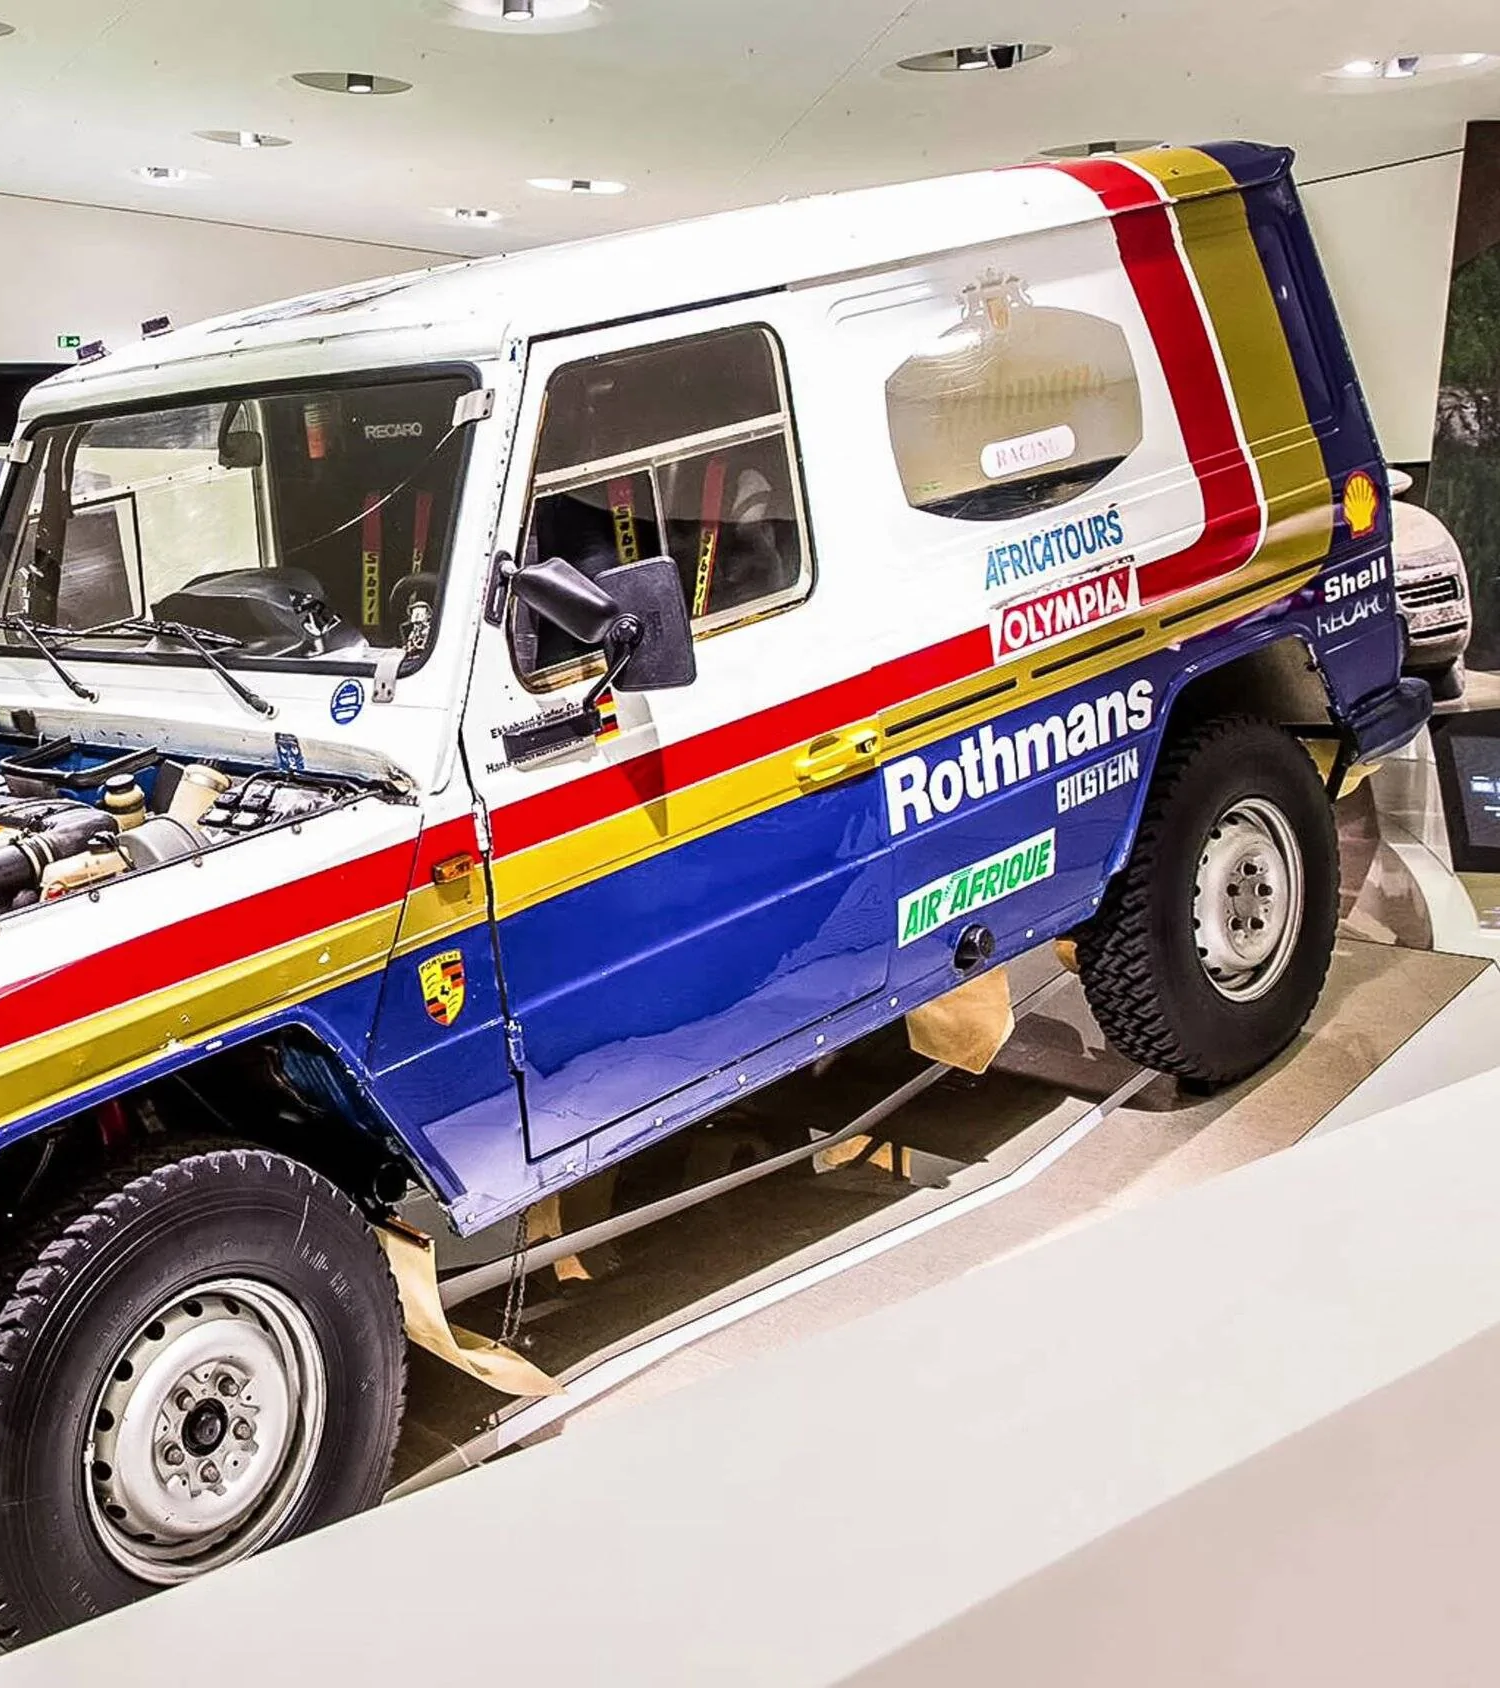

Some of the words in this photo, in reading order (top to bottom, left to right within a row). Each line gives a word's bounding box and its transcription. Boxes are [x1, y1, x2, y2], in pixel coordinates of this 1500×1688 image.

[364, 422, 422, 439] RECARO
[985, 508, 1124, 591] AFRICATOURS
[1324, 556, 1387, 603] Shell
[364, 552, 378, 624] Sabelt
[1003, 576, 1126, 650] OLYMPIA
[882, 678, 1154, 837] Rothmans
[1056, 747, 1139, 815] BILSTEIN
[902, 889, 943, 942] AIR
[949, 839, 1052, 916] AFRIQUE
